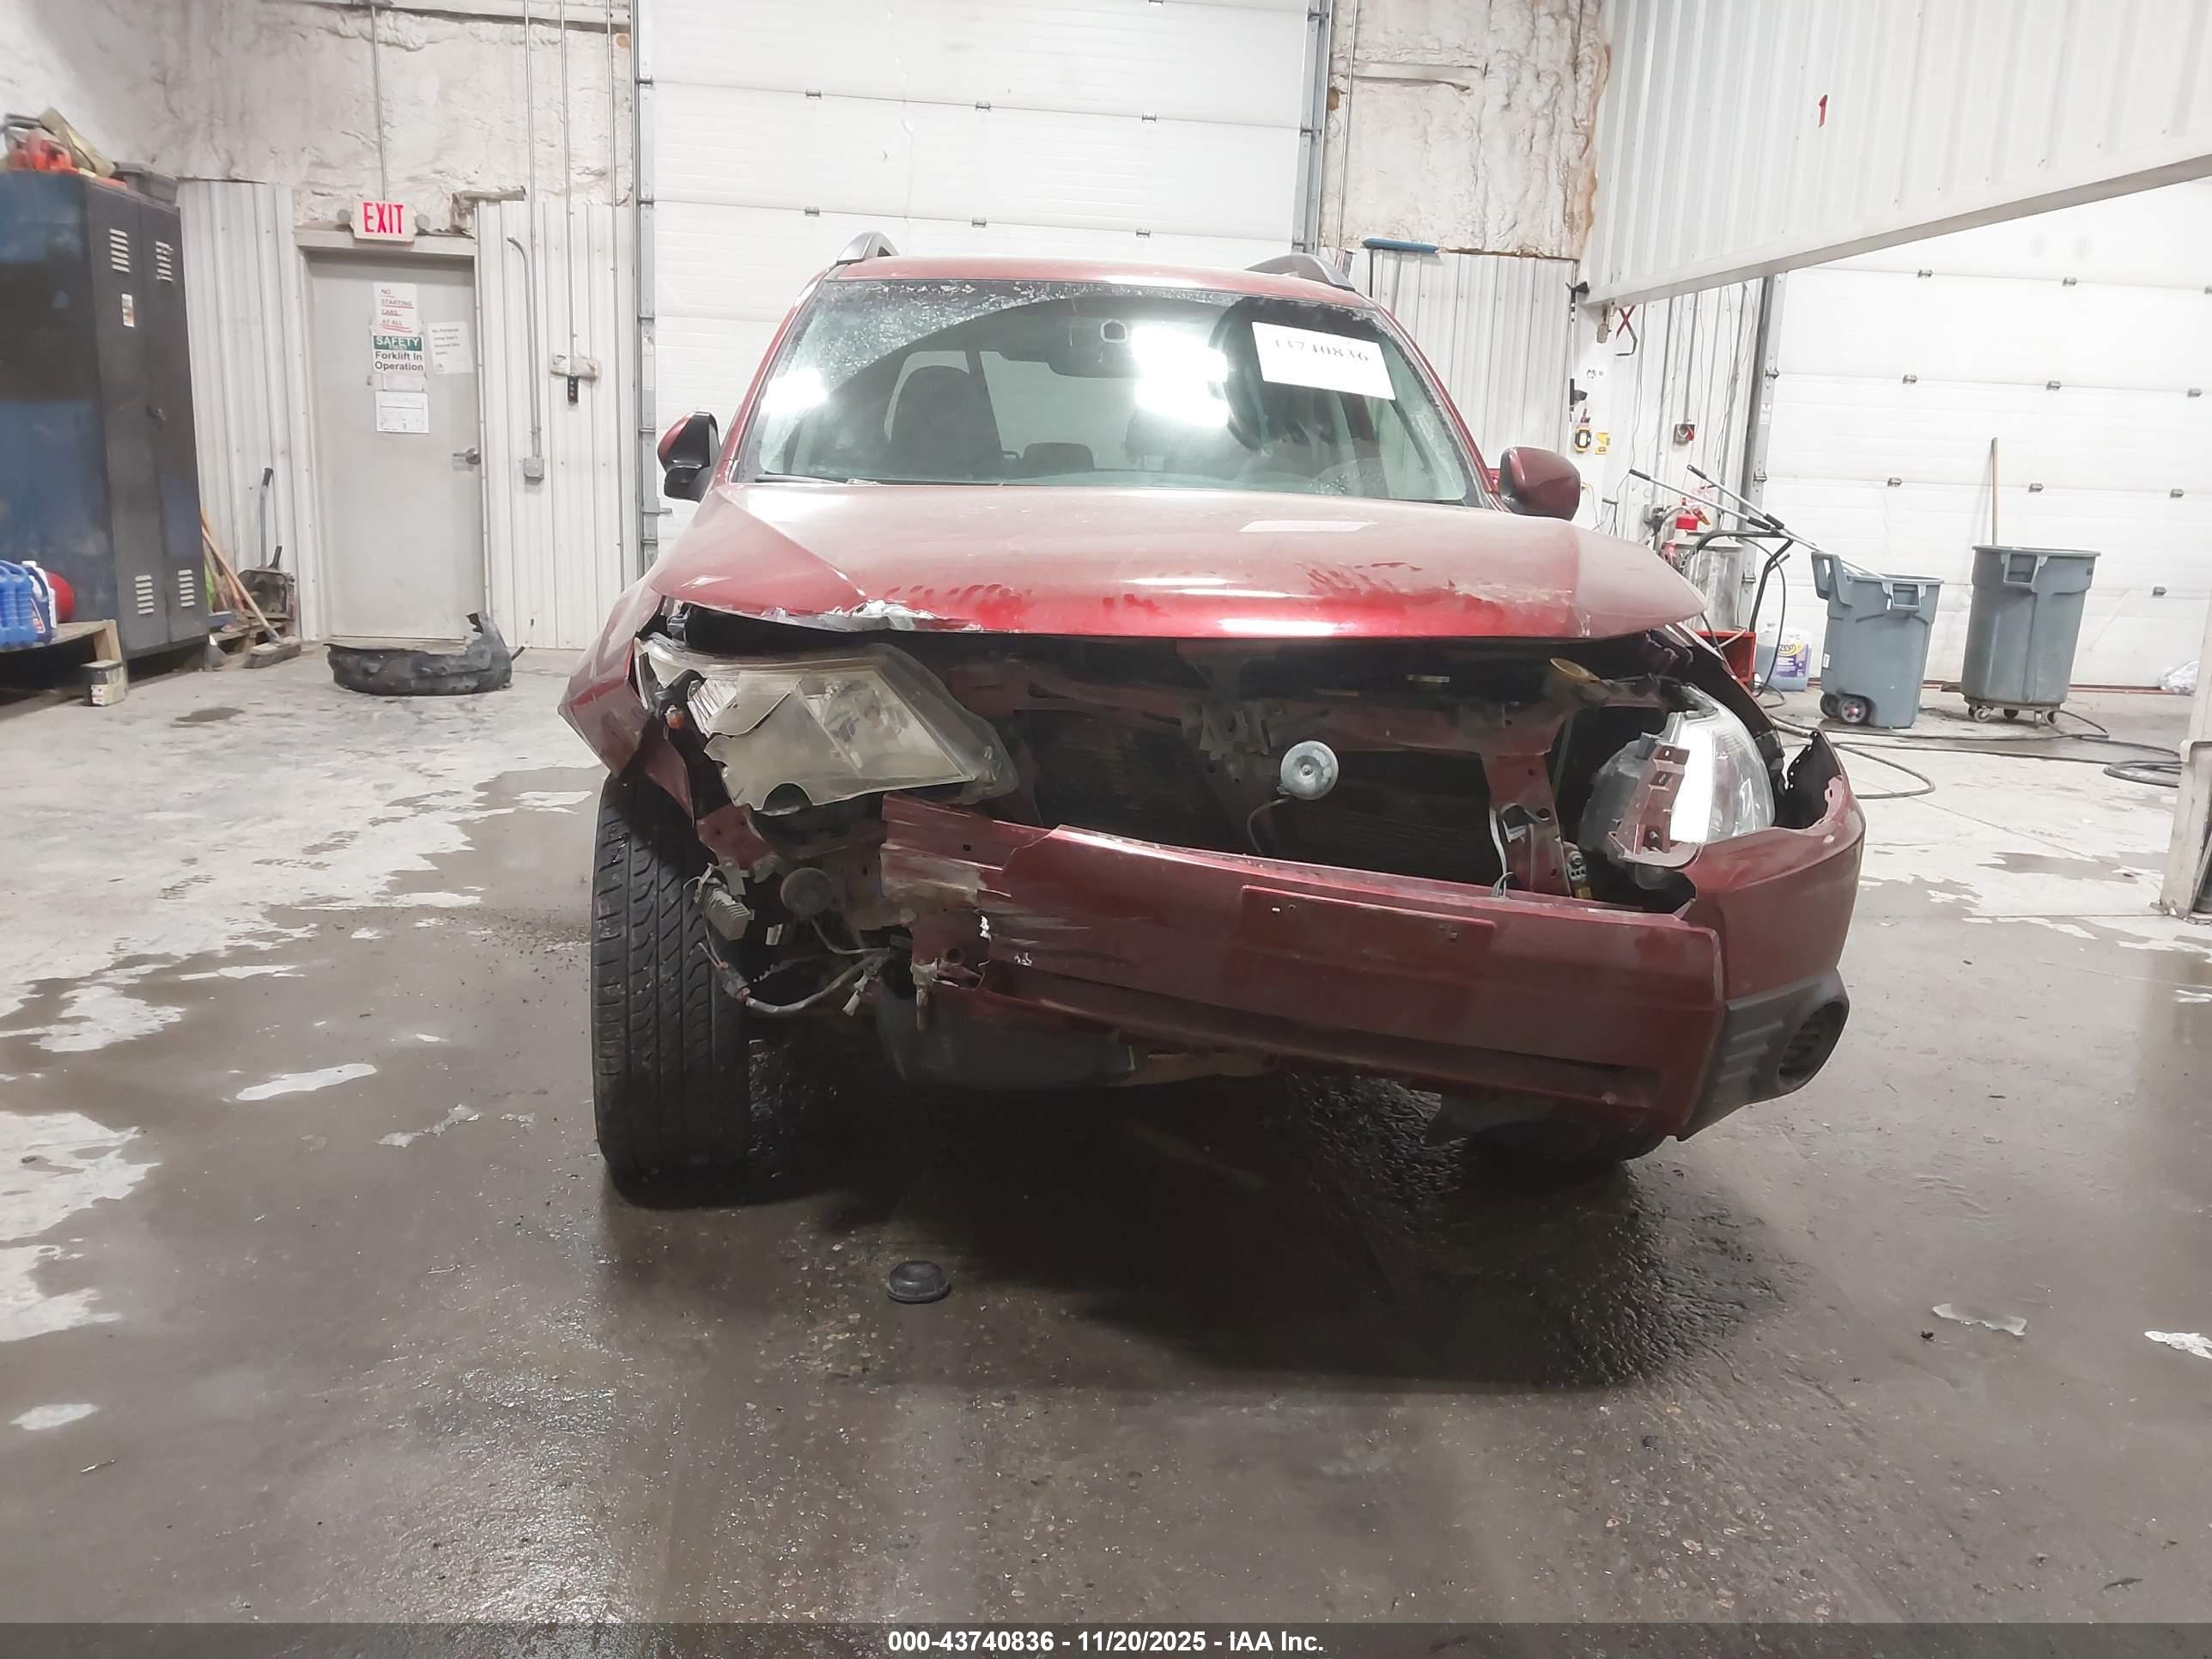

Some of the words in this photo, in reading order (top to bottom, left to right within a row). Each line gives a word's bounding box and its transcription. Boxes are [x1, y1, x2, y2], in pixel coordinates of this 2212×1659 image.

[362, 202, 404, 234] EXIT
[376, 336, 419, 347] SAFETY
[375, 351, 410, 361] Forklift
[413, 352, 422, 362] In
[374, 361, 424, 372] Operation
